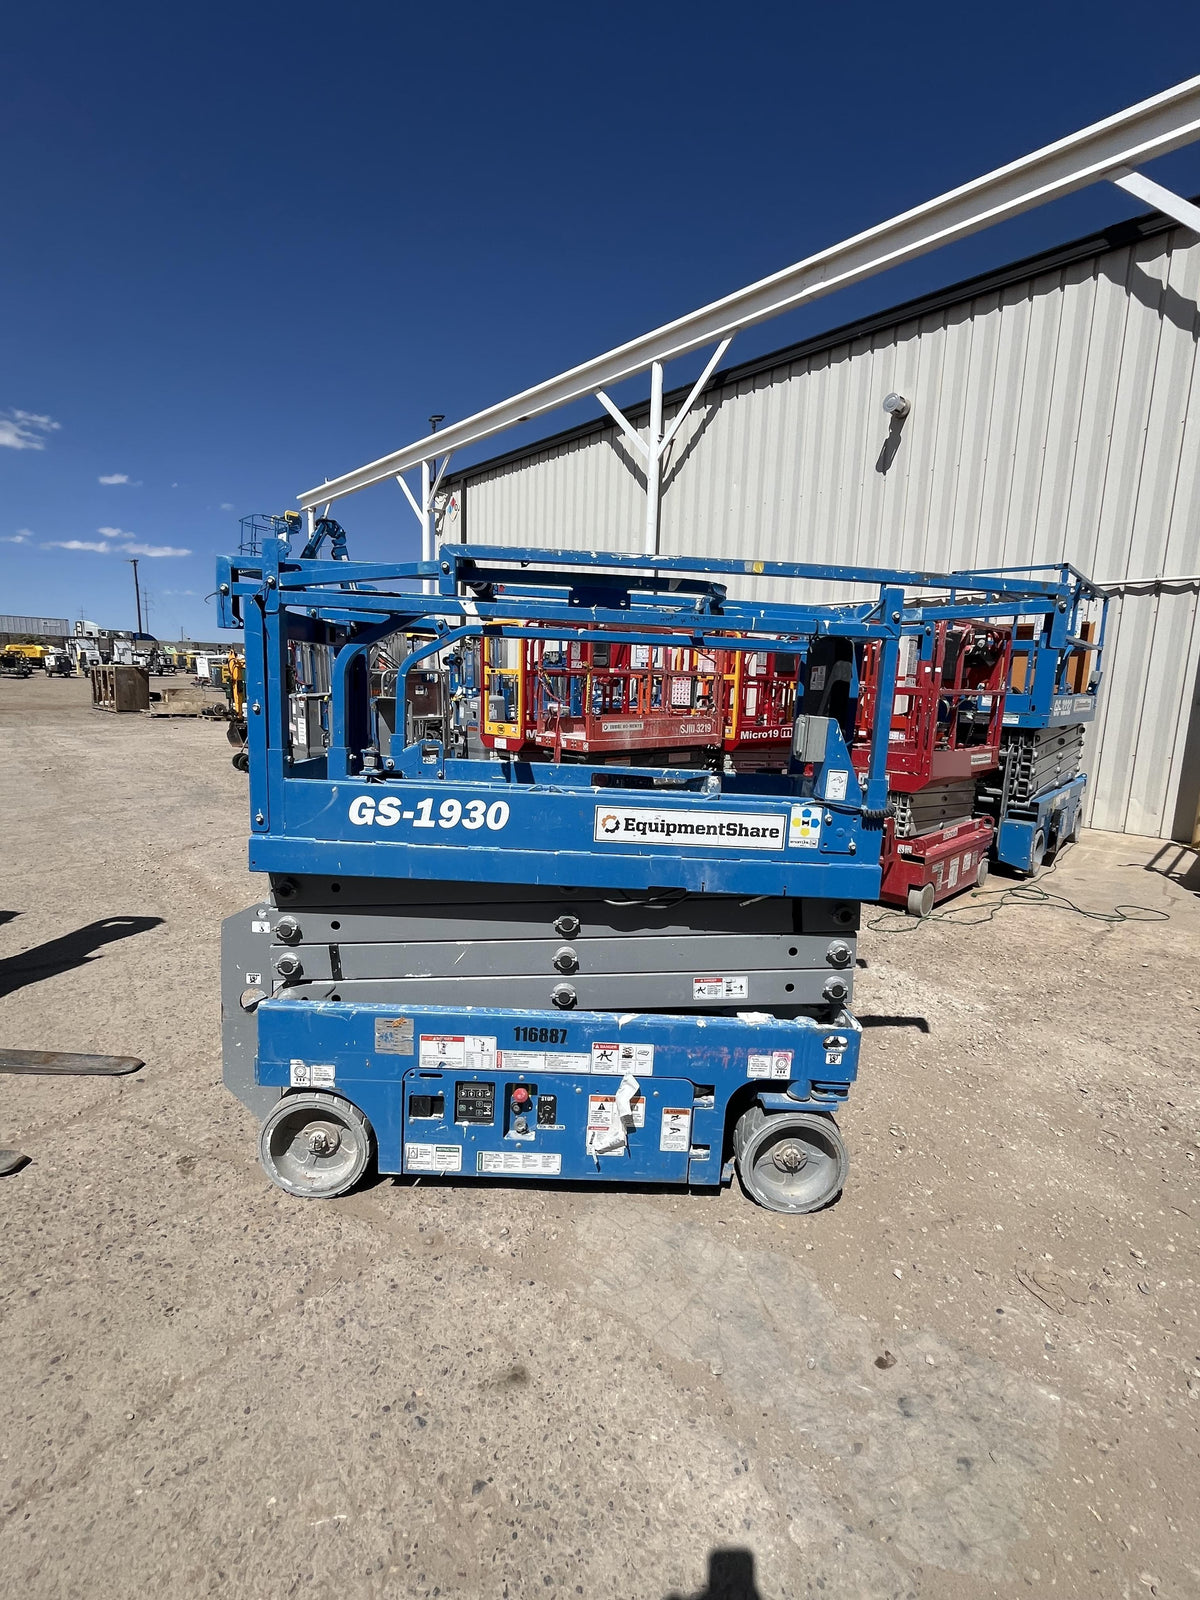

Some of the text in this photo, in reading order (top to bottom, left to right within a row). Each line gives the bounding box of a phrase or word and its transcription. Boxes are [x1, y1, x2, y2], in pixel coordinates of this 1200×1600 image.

[696, 723, 711, 733] 3219
[740, 730, 779, 740] Micro19
[348, 795, 510, 831] GS-1930
[623, 817, 780, 839] EquipmentShare
[513, 1026, 567, 1044] 116887
